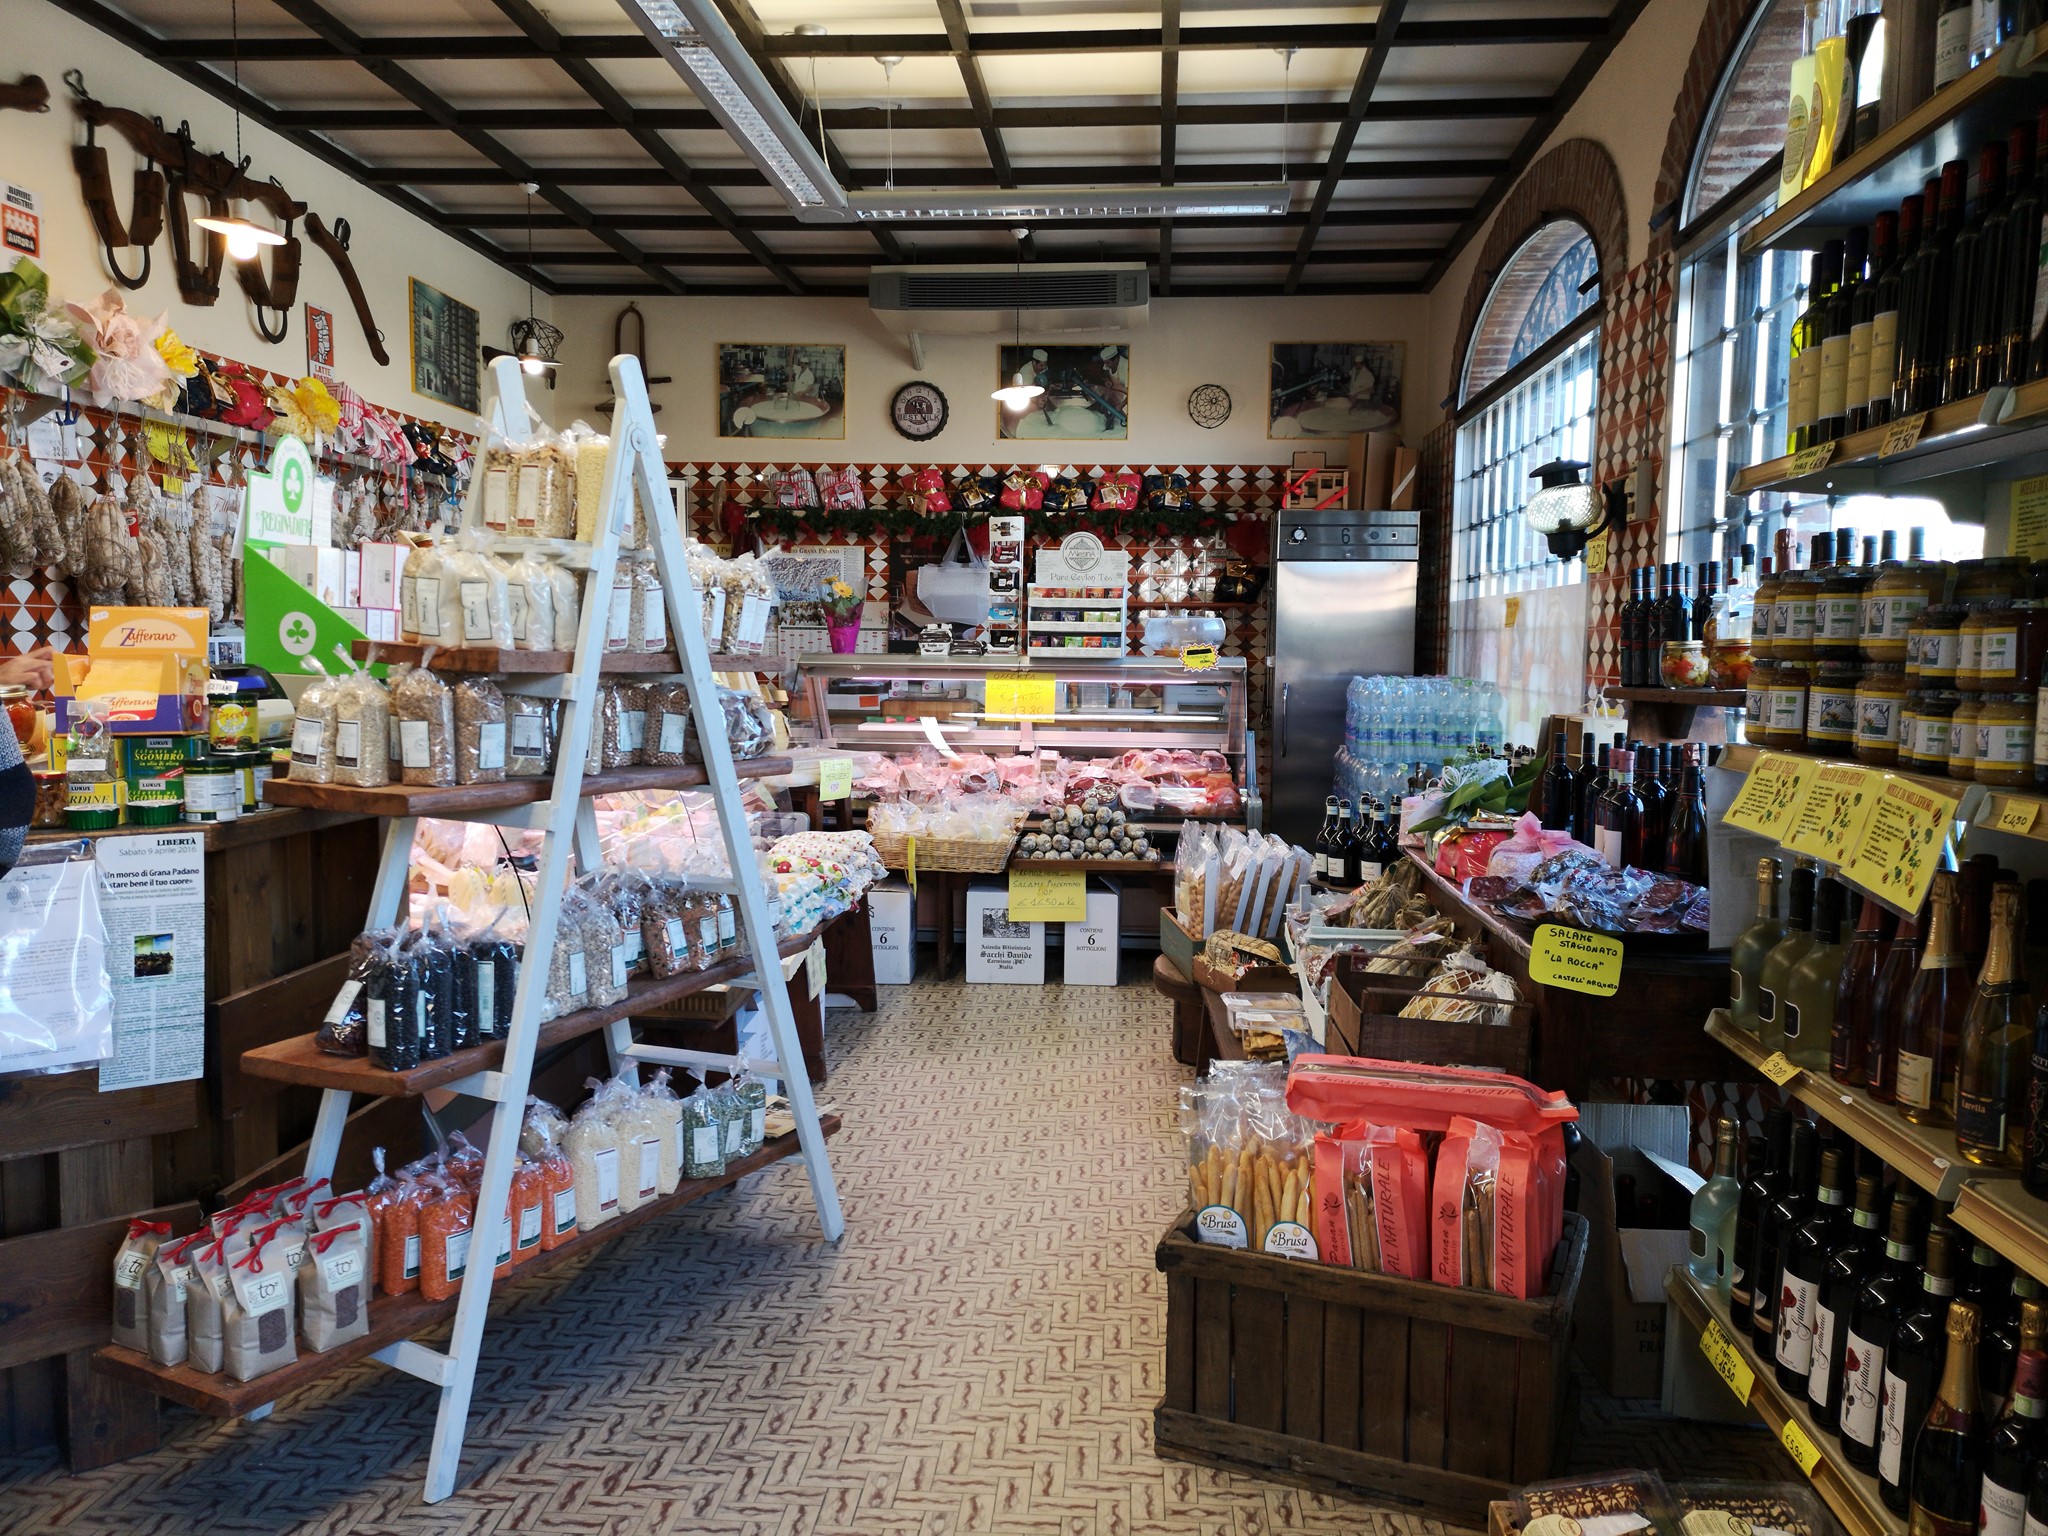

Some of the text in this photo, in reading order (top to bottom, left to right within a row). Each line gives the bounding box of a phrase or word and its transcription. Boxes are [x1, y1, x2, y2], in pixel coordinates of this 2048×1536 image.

[1341, 527, 1351, 545] 6
[1050, 572, 1113, 583] Pure Ceylon Tea
[120, 627, 177, 647] Zafferano
[993, 672, 1036, 680] OFFERTA
[101, 695, 157, 711] Zafferano
[134, 752, 184, 761] SGOMBRO
[69, 795, 110, 804] RDINE
[157, 837, 197, 846] LIBERTÀ
[119, 846, 197, 857] Sabato 9 aprile 2016
[116, 870, 140, 879] morso
[141, 869, 148, 877] di
[109, 881, 128, 889] stare
[129, 880, 149, 888] bene
[879, 932, 888, 944] 6
[1087, 933, 1096, 945] 6
[1549, 927, 1594, 943] SALAME
[1007, 951, 1033, 959] Davide
[1559, 940, 1618, 957] STAGIONATO
[1586, 979, 1618, 990] ARQUATO
[1463, 1088, 1524, 1096] NATUR
[1377, 1157, 1397, 1249] NATURALE
[1206, 1213, 1238, 1229] Brusa
[1276, 1231, 1308, 1247] Brusa
[1500, 1175, 1516, 1295] AL NATURALE
[1789, 1286, 1811, 1341] Gutturnio
[1813, 1313, 1829, 1370] Gutturnio
[1854, 1349, 1877, 1409] Gutturnio
[1883, 1382, 1902, 1446] Gutturnio
